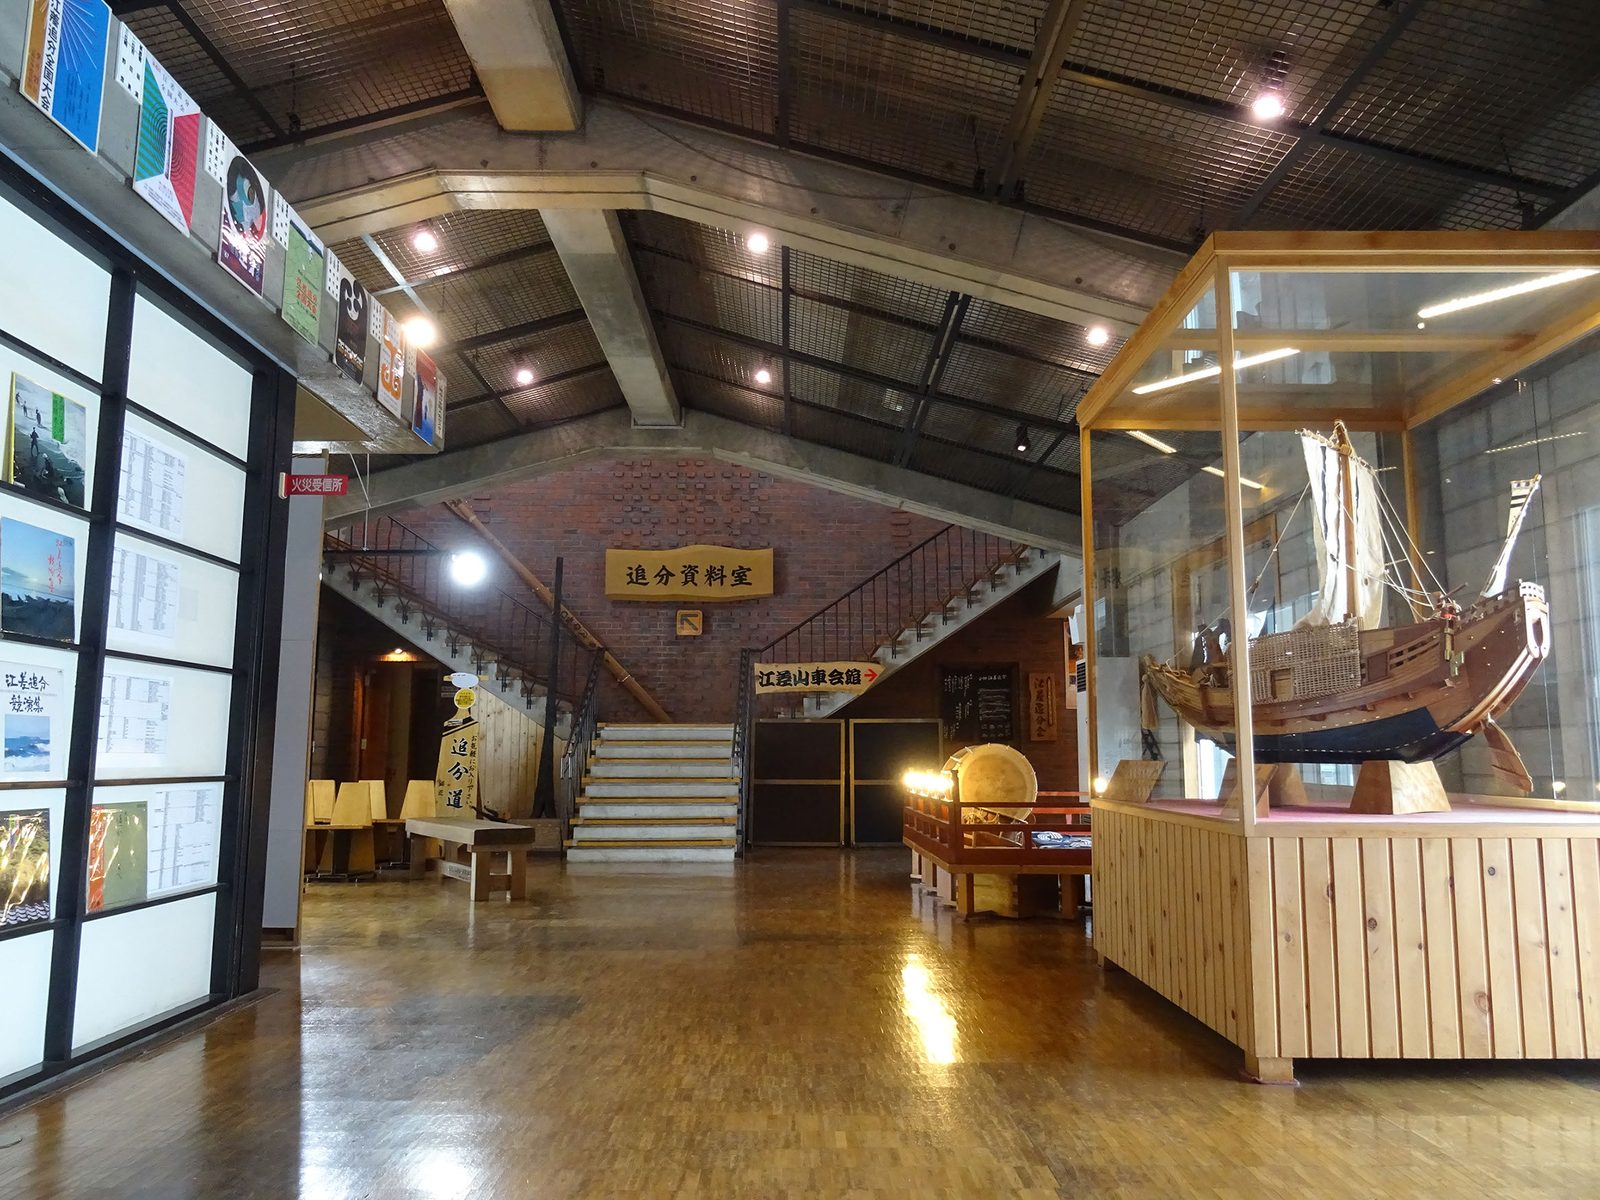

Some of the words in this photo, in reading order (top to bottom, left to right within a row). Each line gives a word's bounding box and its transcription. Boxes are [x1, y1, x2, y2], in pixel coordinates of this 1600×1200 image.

[291, 478, 343, 492] 火災受信所
[626, 564, 753, 587] 追分資料室
[5, 671, 50, 691] 江差追分
[758, 668, 862, 688] 江差山車会館
[446, 738, 468, 807] 追分道
